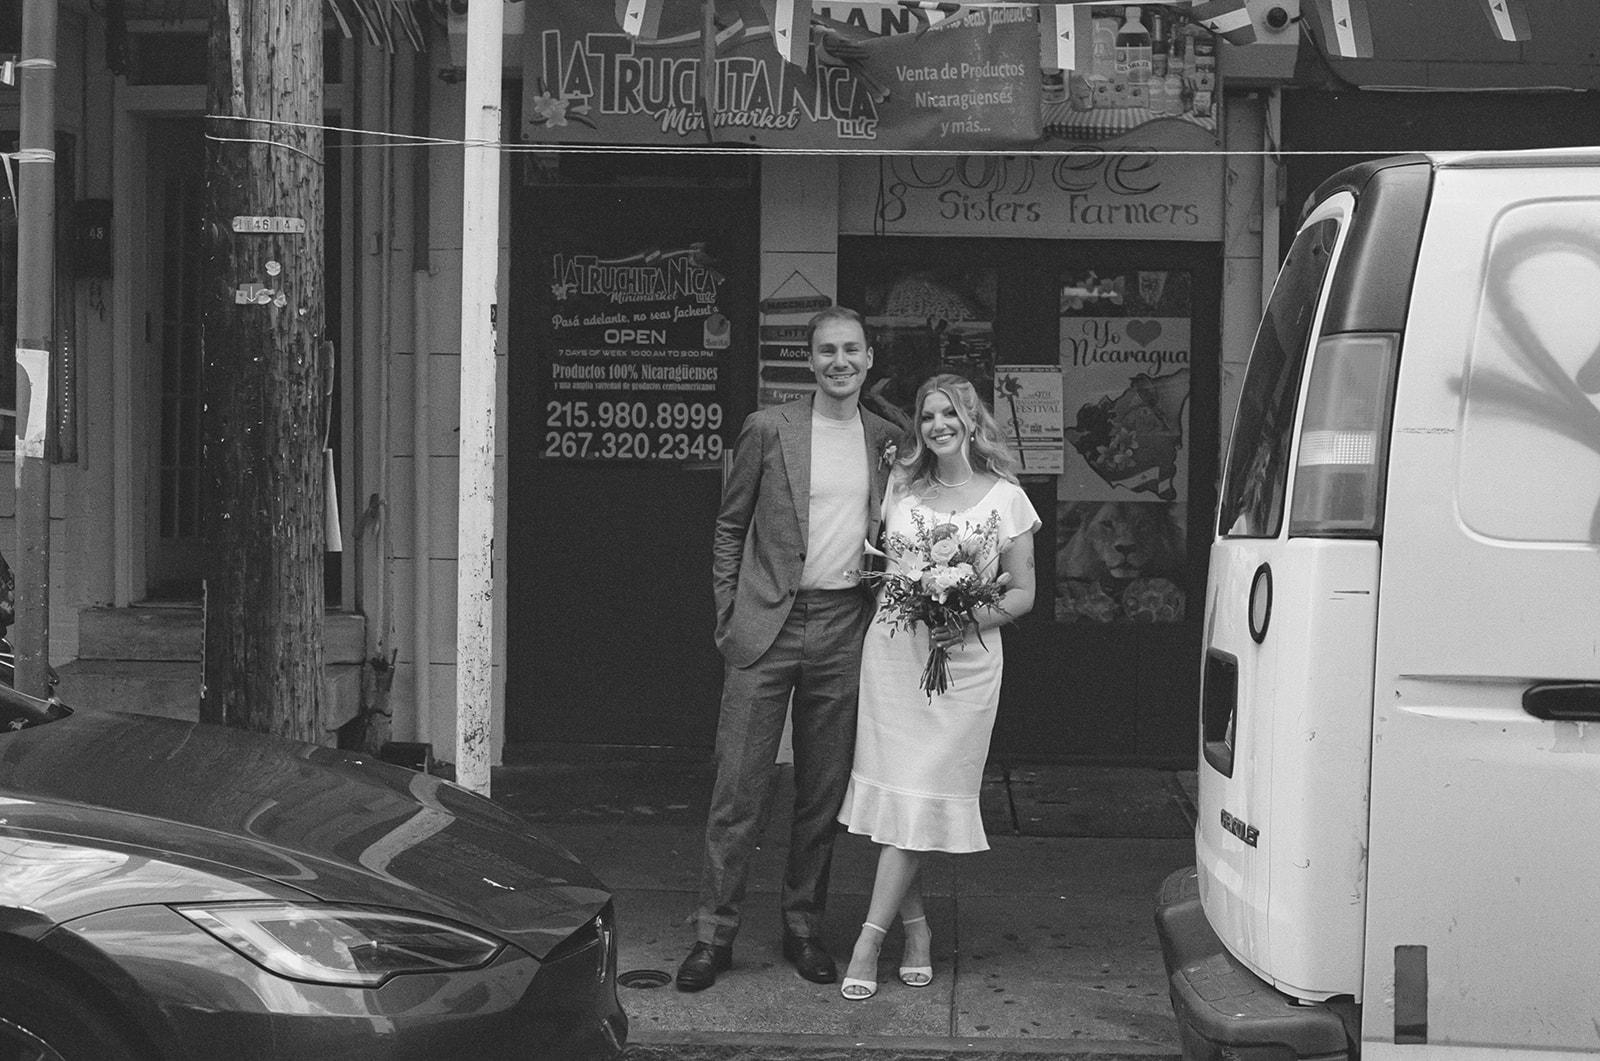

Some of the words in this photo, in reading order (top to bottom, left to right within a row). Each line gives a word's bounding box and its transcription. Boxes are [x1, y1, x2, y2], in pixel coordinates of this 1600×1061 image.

[897, 64, 940, 82] Venta
[941, 63, 959, 80] de
[961, 60, 1025, 81] Productos
[915, 87, 1014, 110] Nicaragüenses
[654, 105, 801, 134] Minmarket
[837, 119, 878, 140] LLC
[940, 121, 952, 137] y
[938, 190, 1042, 223] Sisters
[1069, 193, 1200, 225] Farmers
[551, 313, 580, 330] Pasá
[632, 312, 648, 322] no
[649, 309, 672, 322] seas
[603, 329, 667, 345] OPEN
[1082, 319, 1121, 349] Yo
[565, 349, 588, 357] DAYS
[589, 349, 601, 357] OF
[602, 349, 628, 357] WEEK
[700, 350, 714, 358] PM
[1063, 337, 1189, 375] Nicaragua
[552, 363, 606, 380] Productos
[608, 364, 639, 380] 100%
[641, 364, 719, 383] Nicaragüenses
[546, 400, 723, 430] 215.980.8999
[1016, 405, 1061, 413] FESTIVAL
[545, 431, 723, 460] 267.320.2349
